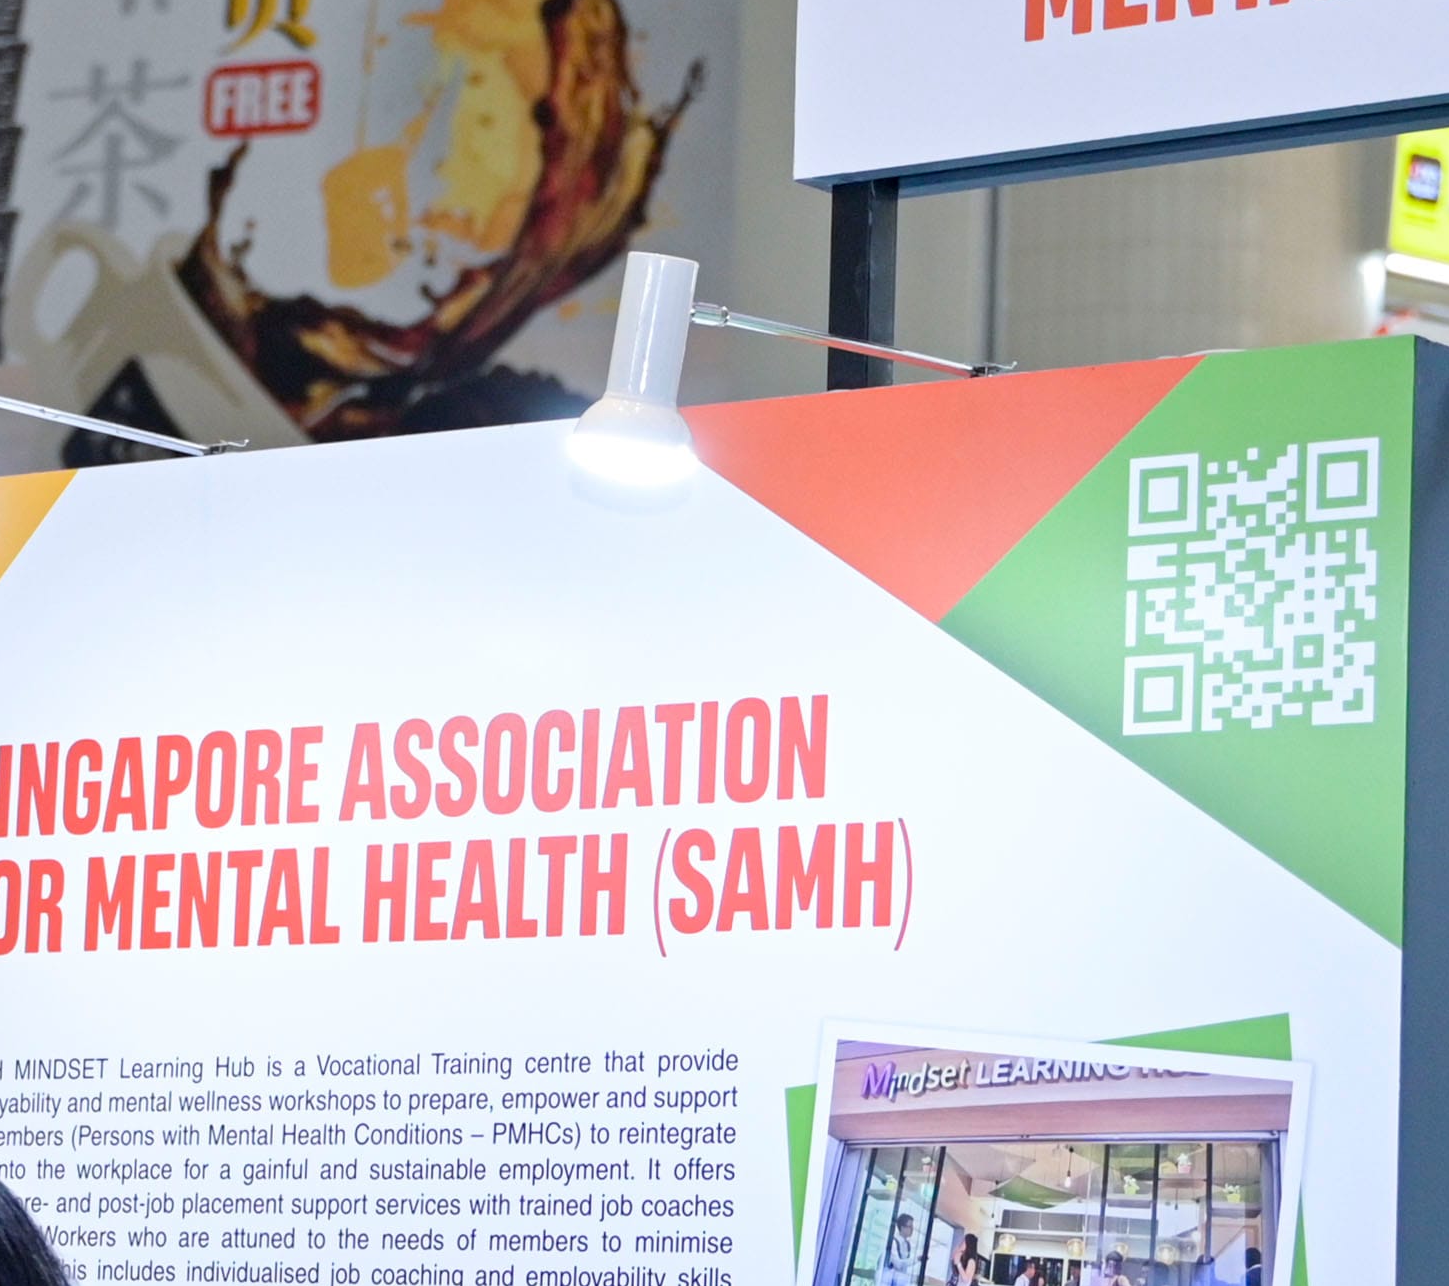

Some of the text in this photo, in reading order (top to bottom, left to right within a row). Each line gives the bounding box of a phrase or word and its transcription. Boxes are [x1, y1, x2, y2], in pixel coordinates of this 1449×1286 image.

[212, 69, 316, 131] FREE
[340, 695, 828, 821] ASSOCIATION
[84, 847, 340, 953] MENTAL
[362, 832, 628, 942] HEALTH
[653, 818, 913, 958] (SAMH)
[14, 1057, 109, 1081] MINDSET
[119, 1057, 204, 1085] Learning
[215, 1055, 255, 1078] Hub
[266, 1059, 283, 1078] is
[293, 1059, 306, 1078] a
[316, 1052, 421, 1077] Vocational
[430, 1052, 513, 1081] Training
[524, 1051, 592, 1075] centre
[603, 1049, 645, 1073] that
[657, 1047, 739, 1079] provide
[861, 1059, 972, 1100] Mindset
